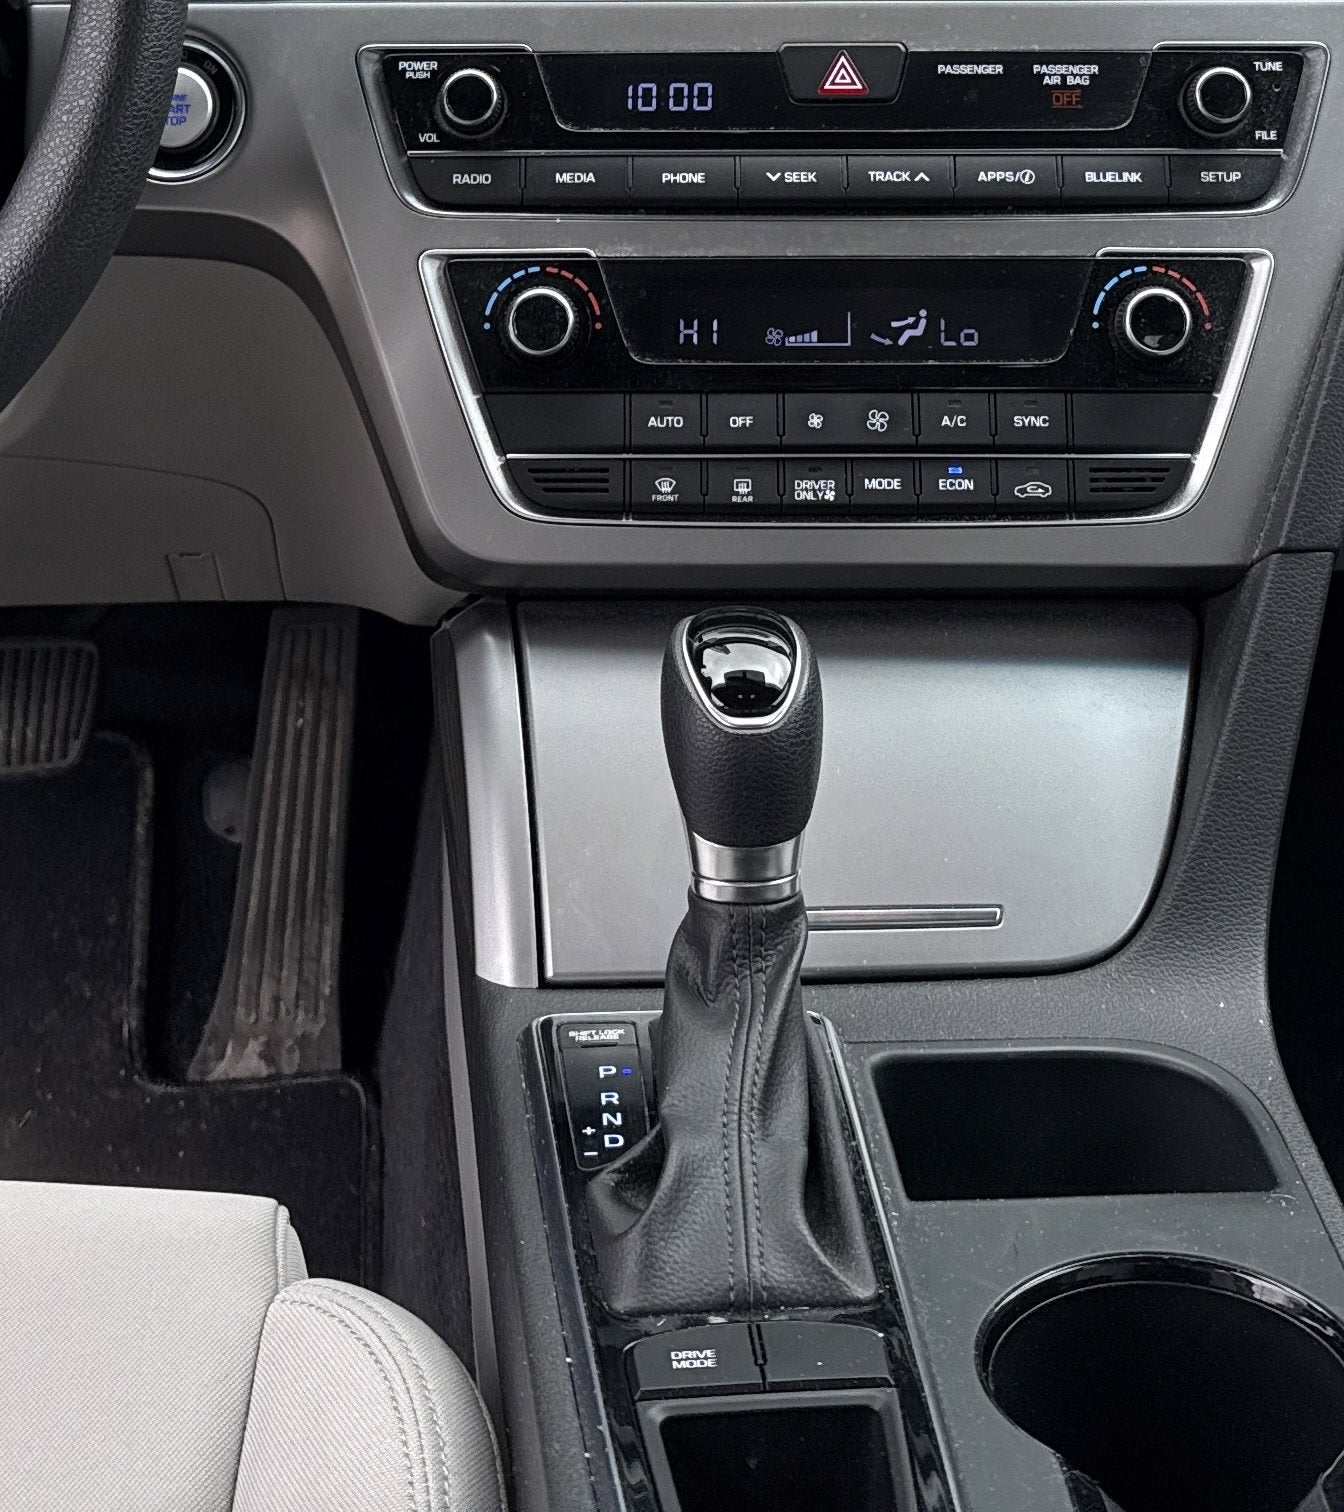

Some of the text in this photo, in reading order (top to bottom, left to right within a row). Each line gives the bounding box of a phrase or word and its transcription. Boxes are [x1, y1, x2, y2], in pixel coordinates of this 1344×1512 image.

[398, 61, 438, 71] POWER
[937, 64, 1003, 75] PASSENGER
[1033, 64, 1099, 75] PASSENGER
[1253, 61, 1283, 71] TUNE
[405, 71, 431, 79] PUSH
[1042, 75, 1090, 85] AIR BAG
[1052, 92, 1081, 105] OFF
[169, 104, 191, 114] ART
[166, 116, 187, 126] TOP
[418, 133, 440, 143] VOL
[1255, 130, 1277, 141] FILE
[452, 173, 492, 185] RADIO
[556, 172, 595, 184] MEDIA
[662, 172, 706, 184] PHONE
[784, 171, 817, 183] SEEK
[868, 171, 911, 183] TRACK
[1085, 171, 1142, 183] BLUELINK
[1200, 171, 1241, 183] SETUP
[647, 416, 684, 428] AUTO
[729, 416, 753, 428] OFF
[941, 414, 967, 427] A/C
[1013, 415, 1050, 427] SYNC
[794, 480, 836, 489] DRIVER
[864, 478, 902, 490] MODE
[938, 479, 974, 491] ECON
[652, 494, 679, 502] FRONT
[732, 495, 753, 503] REAR
[794, 490, 825, 501] ONLY
[598, 1065, 617, 1079] P
[600, 1092, 620, 1106] R
[602, 1112, 622, 1126] N
[603, 1134, 624, 1148] D
[670, 1349, 716, 1359] DRIVE
[672, 1358, 718, 1369] MODE
